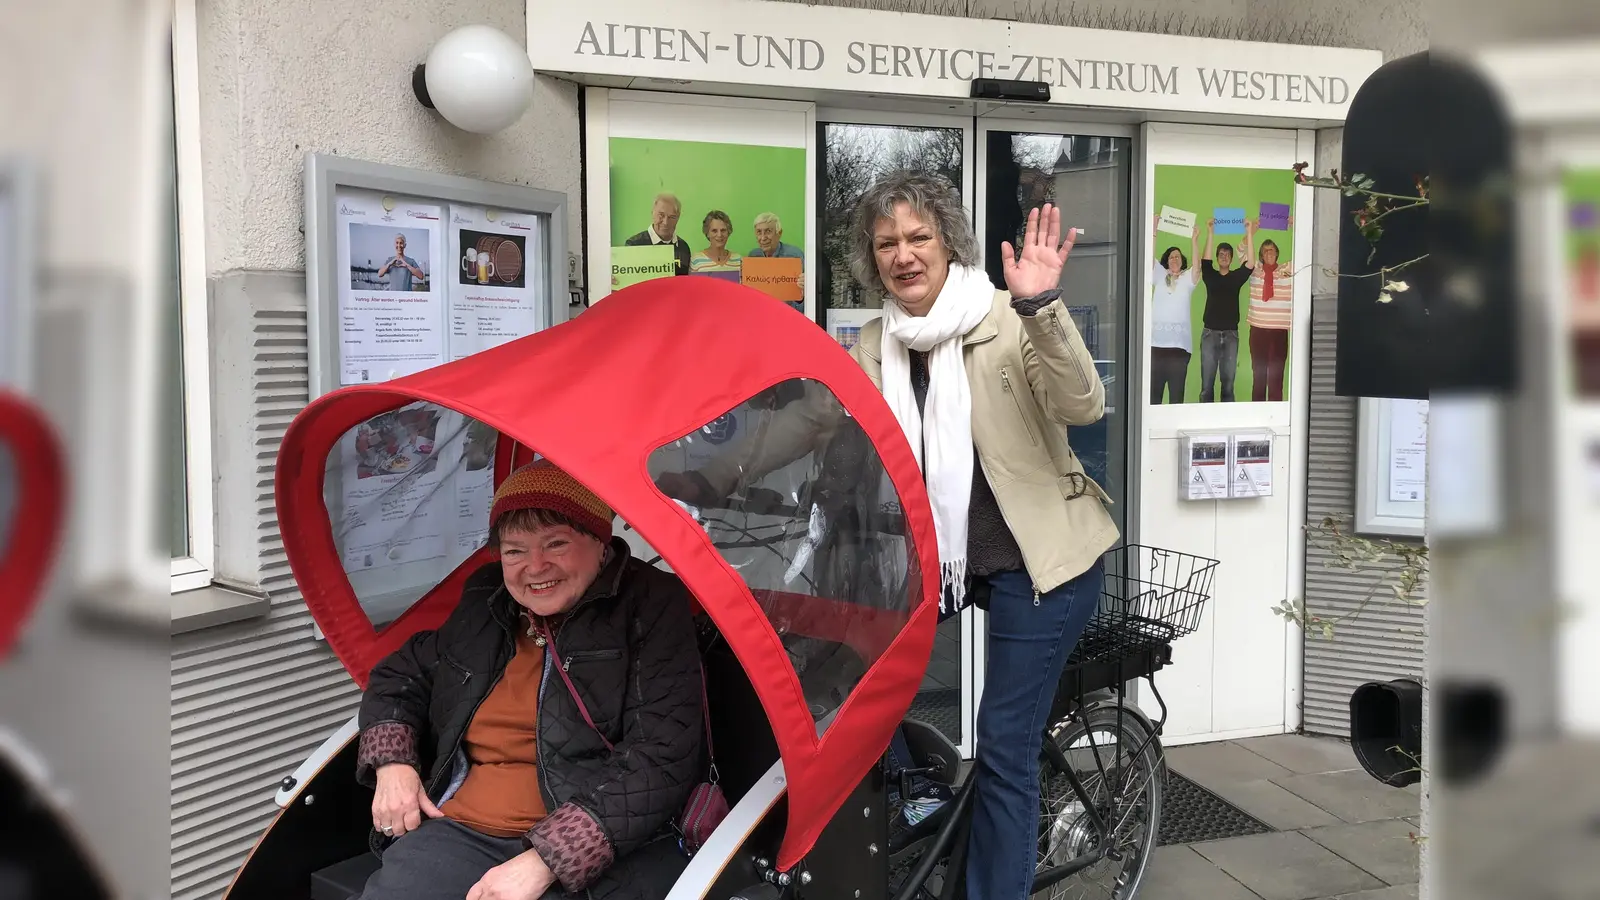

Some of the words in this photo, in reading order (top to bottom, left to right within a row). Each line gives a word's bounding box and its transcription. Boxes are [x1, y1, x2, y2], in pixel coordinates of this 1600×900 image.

[574, 21, 825, 71] ALTEN-UND
[847, 41, 1180, 95] SERVICE-ZENTRUM
[1196, 67, 1350, 105] WESTEND
[612, 262, 674, 275] Benvenuti!
